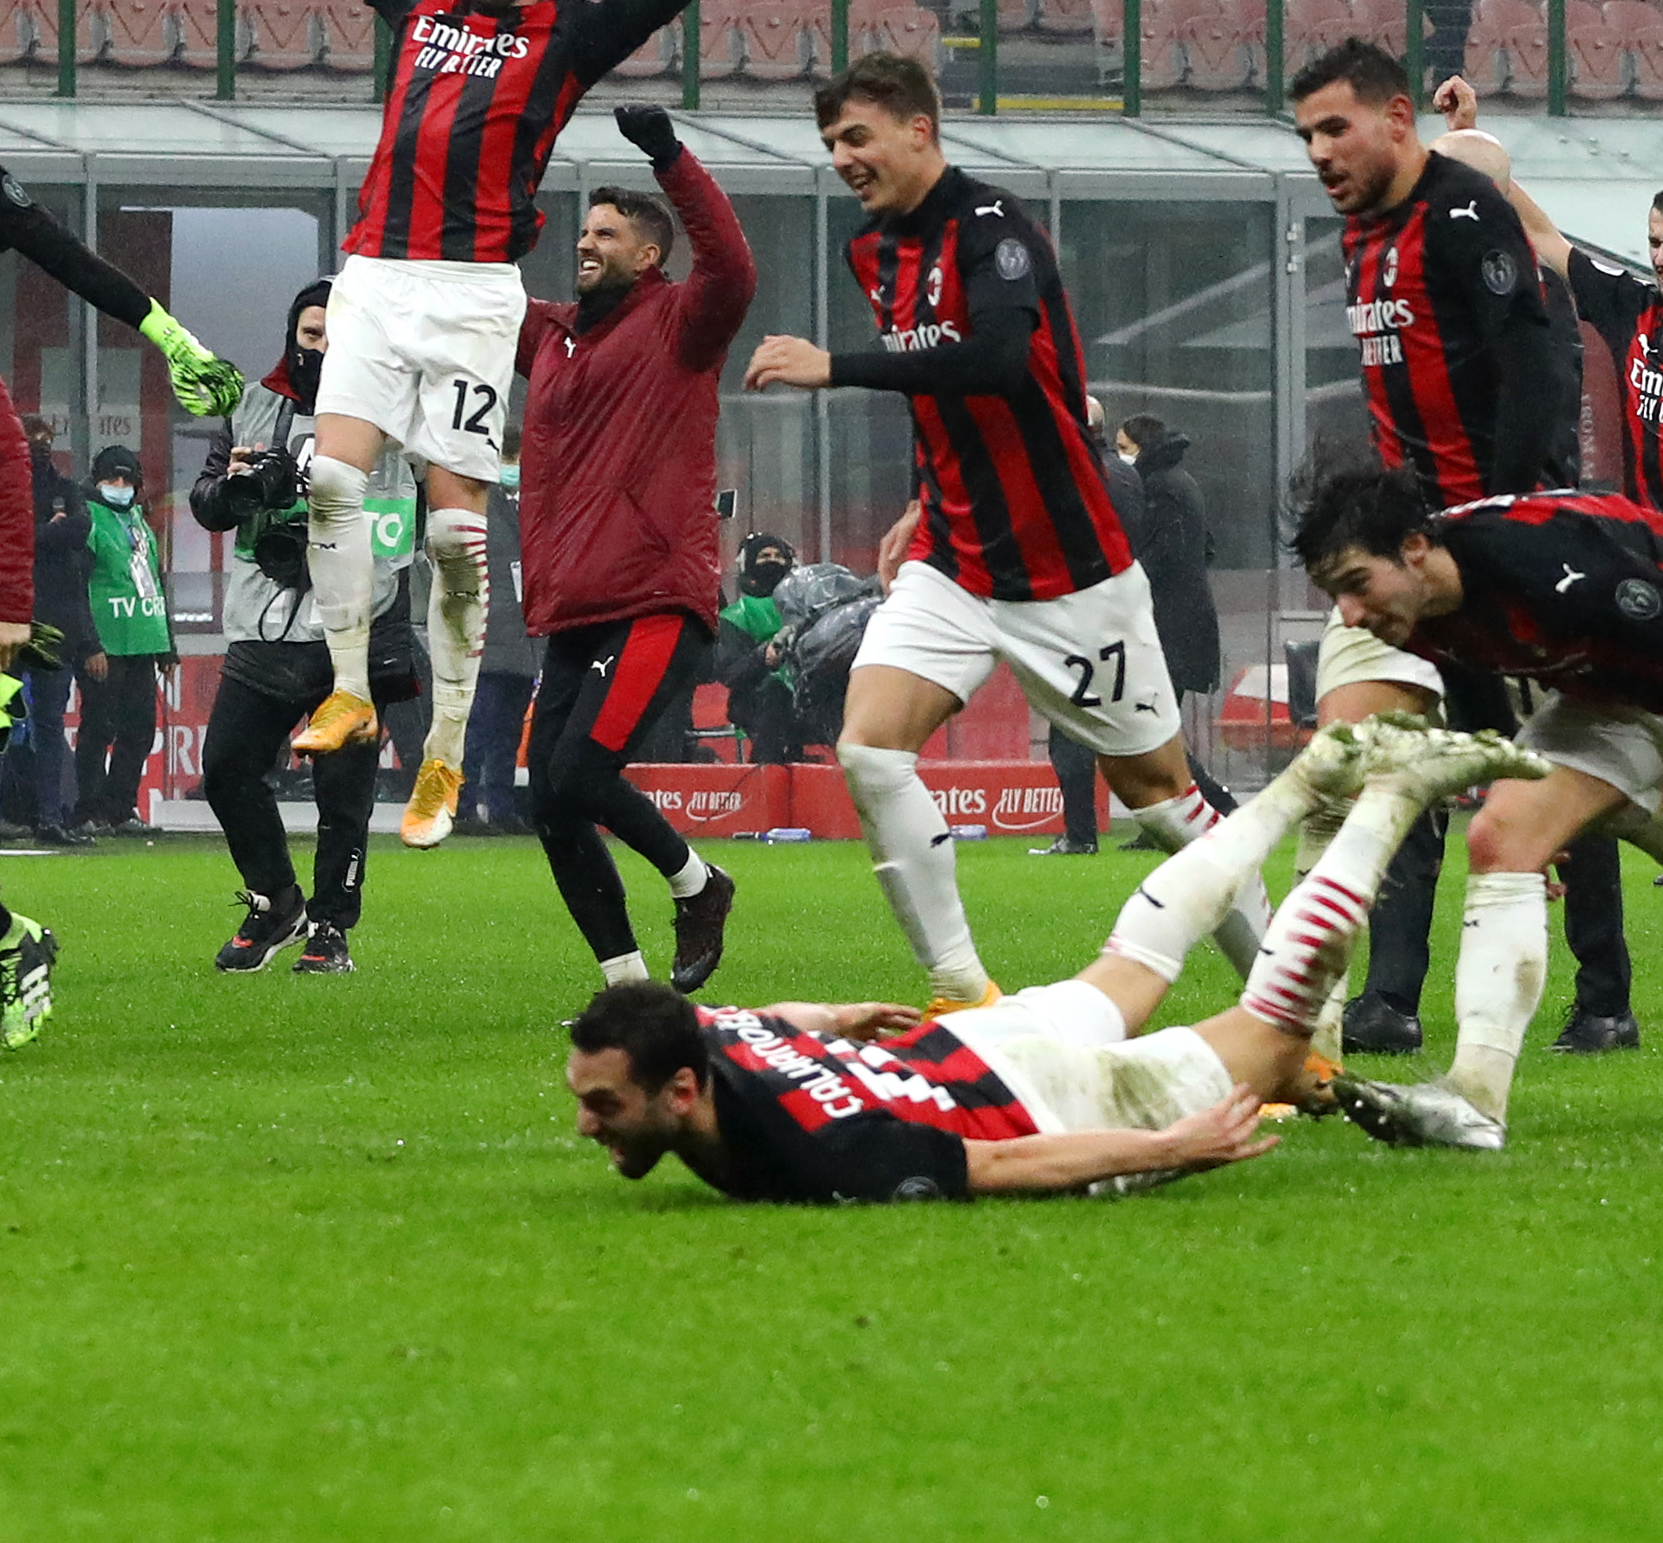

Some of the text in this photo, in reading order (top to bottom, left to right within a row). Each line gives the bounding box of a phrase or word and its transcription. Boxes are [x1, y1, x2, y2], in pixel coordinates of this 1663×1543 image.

[414, 46, 447, 69] FLY
[452, 379, 497, 436] 12
[108, 597, 136, 618] TV
[1064, 640, 1126, 707] 27
[691, 791, 708, 810] FLY
[999, 788, 1022, 813] FLY
